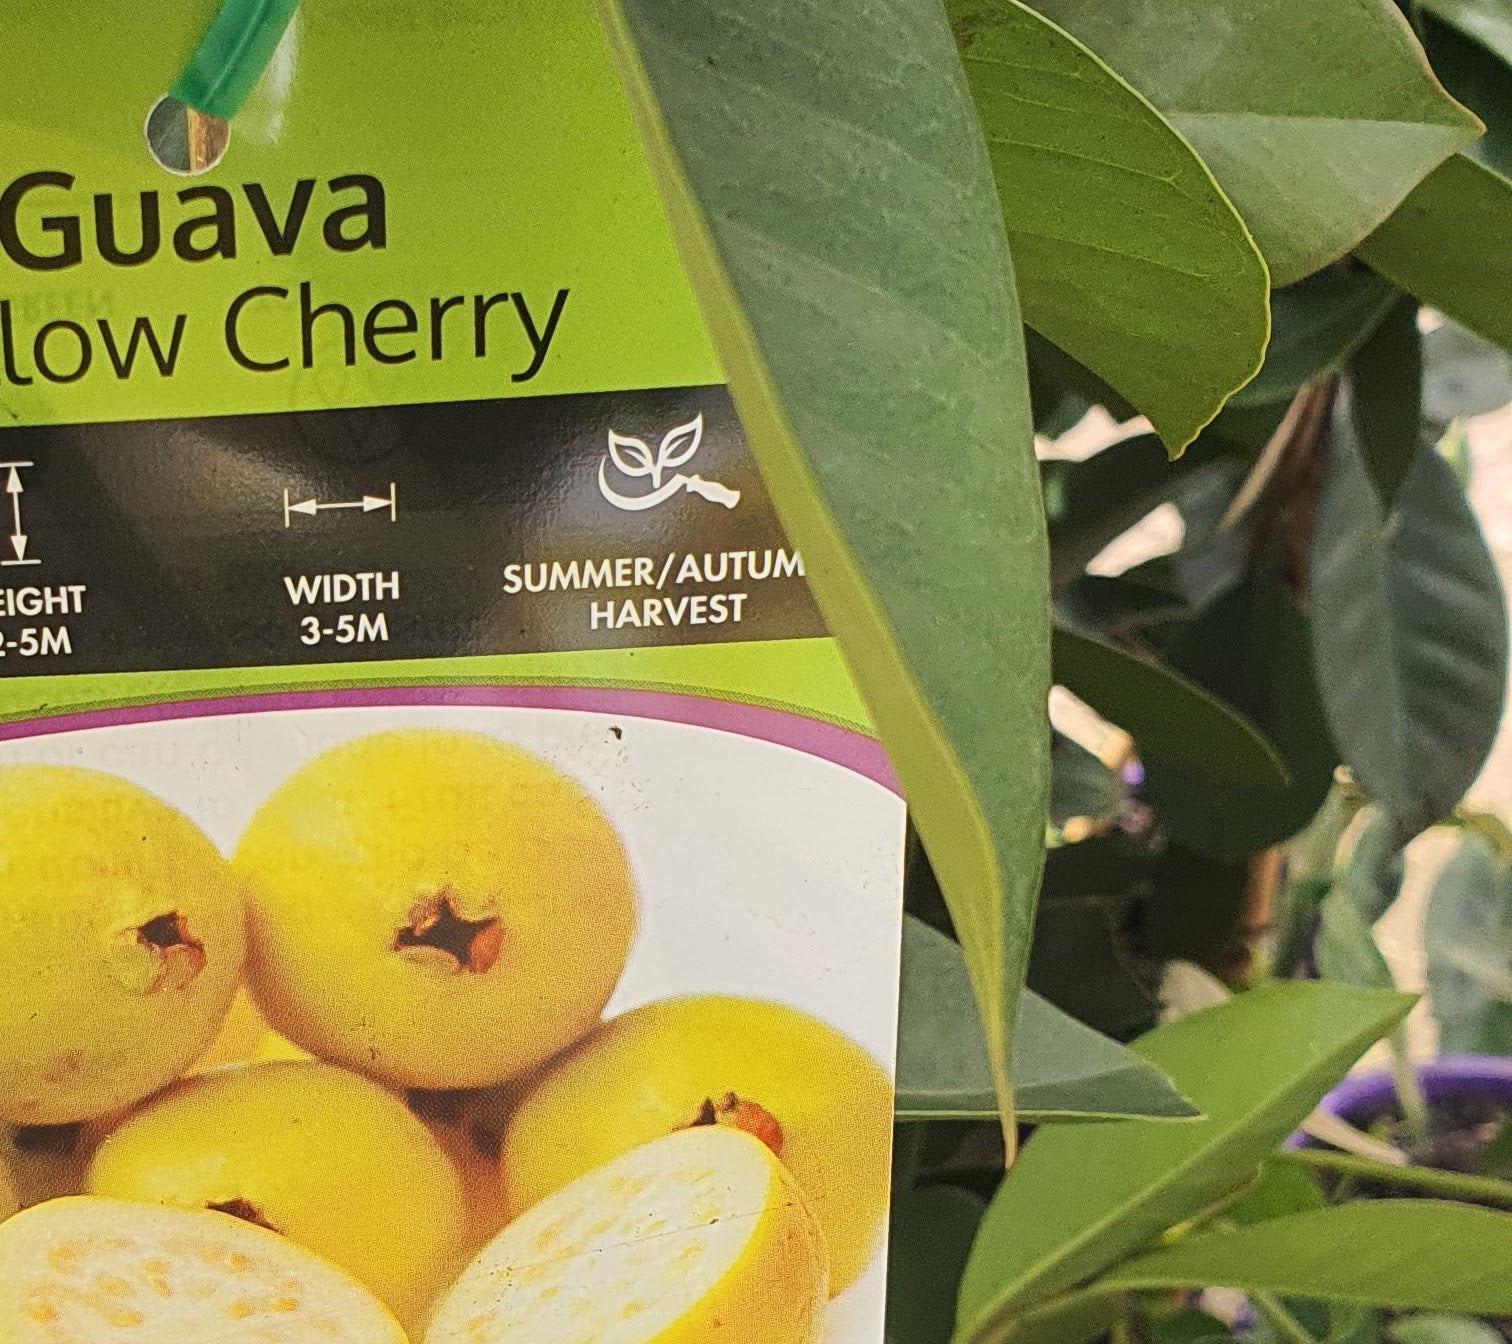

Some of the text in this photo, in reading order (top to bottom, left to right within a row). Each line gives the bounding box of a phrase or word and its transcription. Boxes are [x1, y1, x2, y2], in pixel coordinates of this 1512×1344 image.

[224, 281, 570, 383] Cherry
[284, 571, 400, 605] WIDTH
[503, 549, 807, 594] SUMMER/AUTUM
[300, 613, 388, 644] 3-5M
[589, 593, 748, 630] HARVEST
